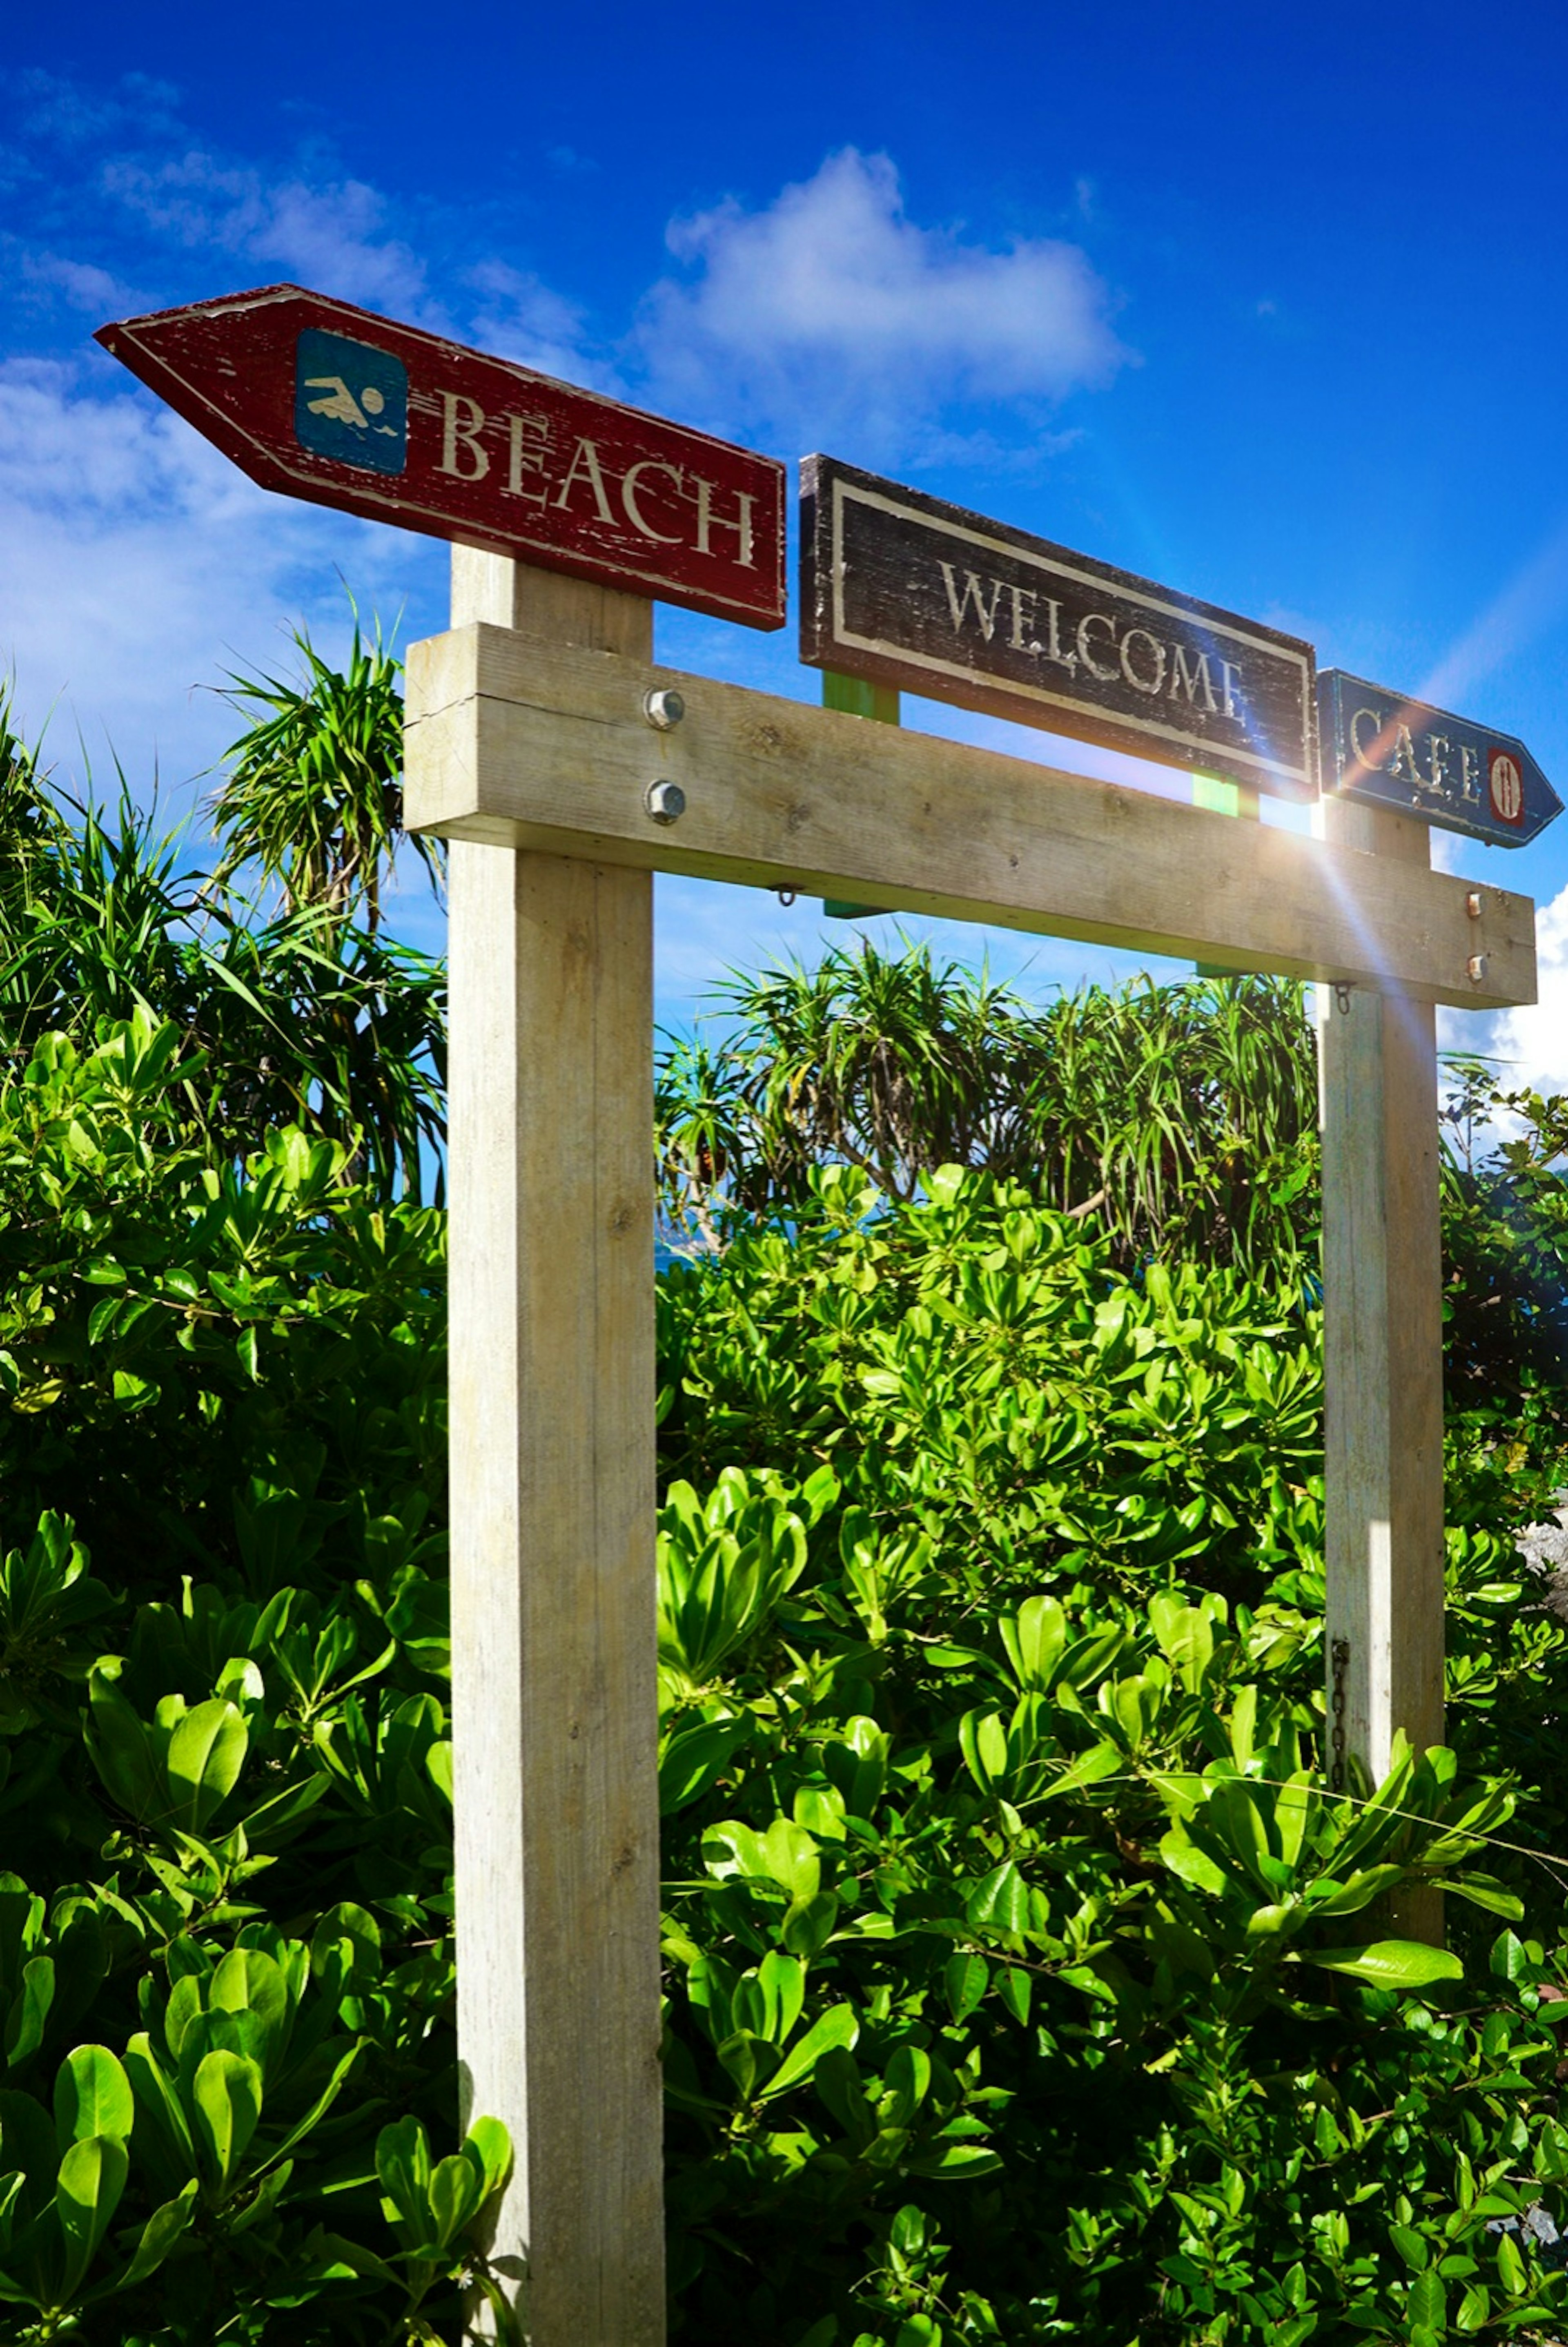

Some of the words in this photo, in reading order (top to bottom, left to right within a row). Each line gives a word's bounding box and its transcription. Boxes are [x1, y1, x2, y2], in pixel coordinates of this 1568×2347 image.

[432, 388, 758, 570] BEACH
[936, 559, 1246, 727] WELCOME
[1350, 708, 1480, 807] CAFE
